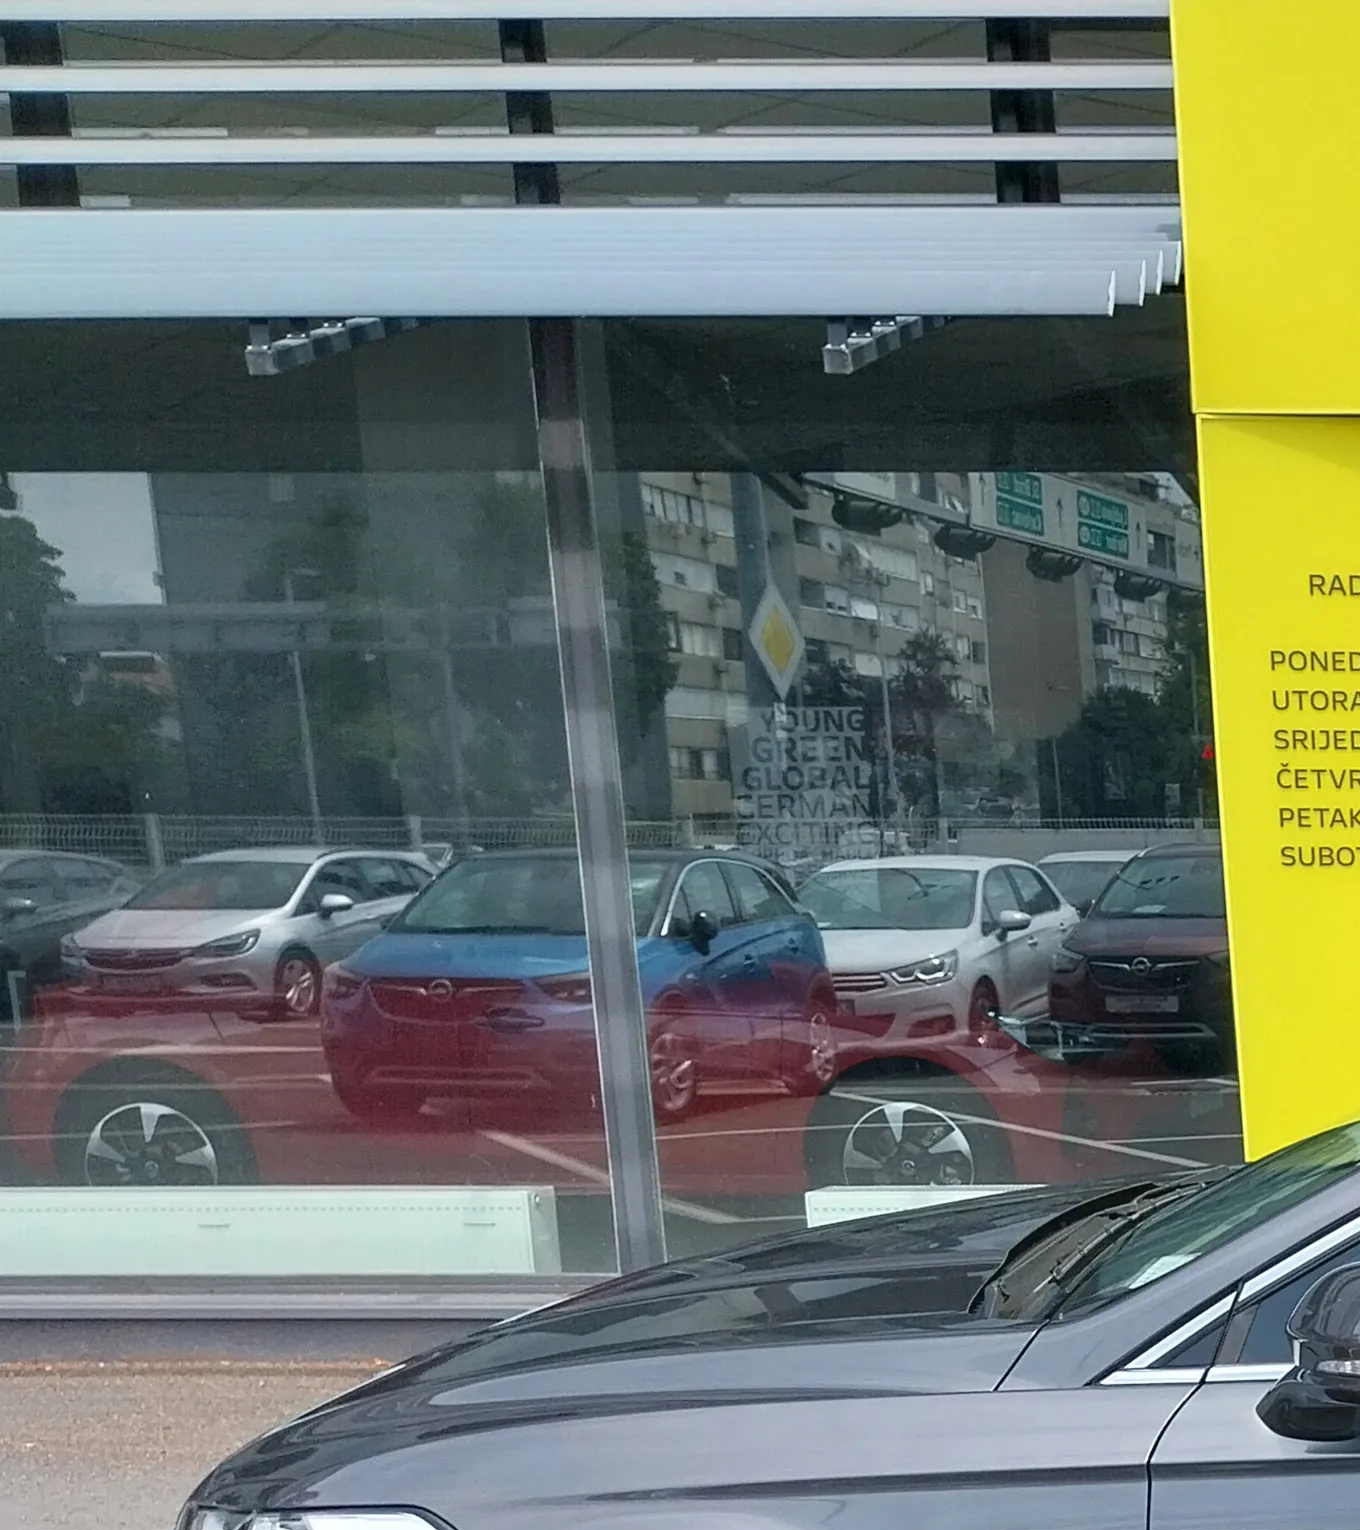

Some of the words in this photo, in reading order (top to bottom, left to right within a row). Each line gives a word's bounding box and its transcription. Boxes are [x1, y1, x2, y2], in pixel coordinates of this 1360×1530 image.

[761, 710, 865, 732] YOUNG
[752, 736, 866, 762] GREEN
[742, 765, 871, 790] GLOBAL
